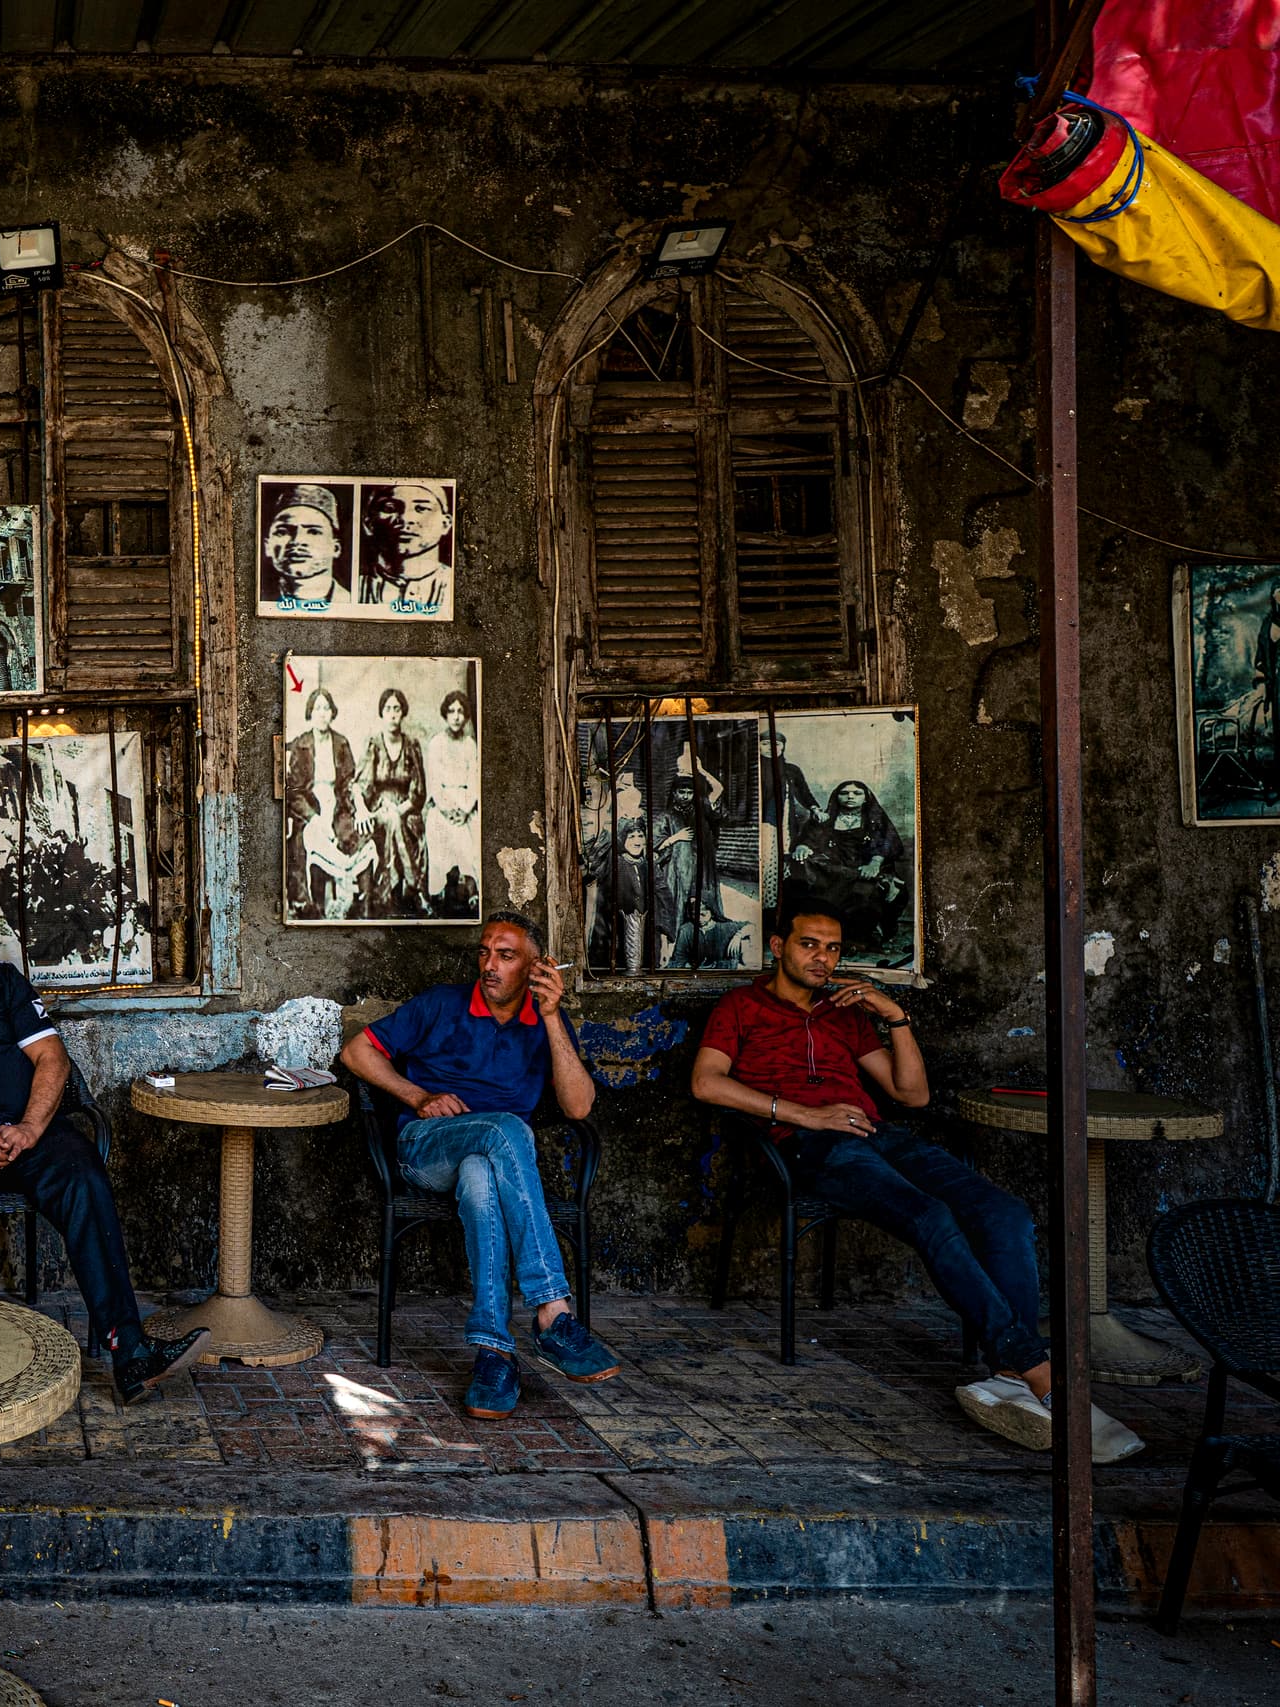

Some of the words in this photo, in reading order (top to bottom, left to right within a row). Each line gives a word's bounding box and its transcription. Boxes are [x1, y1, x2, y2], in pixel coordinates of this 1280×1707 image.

[278, 599, 297, 610] الله
[302, 600, 329, 610] حسب
[392, 600, 417, 612] العال
[421, 602, 439, 613] عبد
